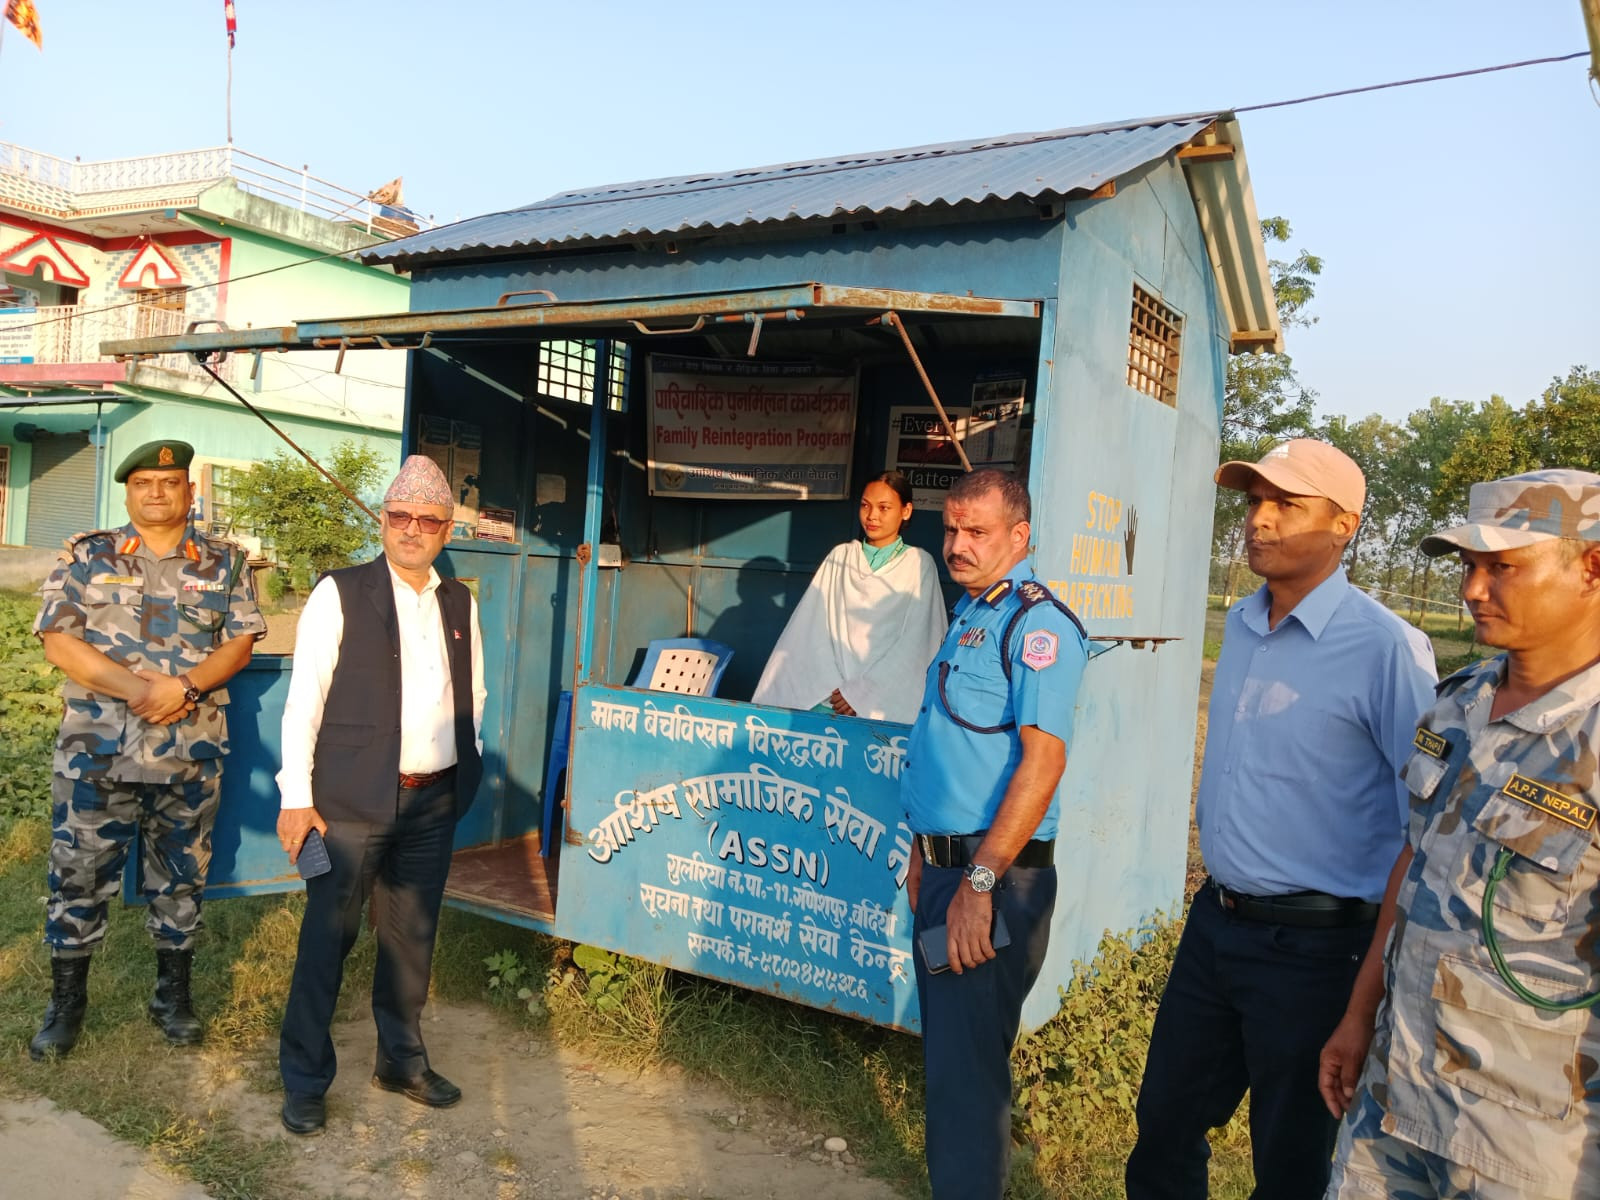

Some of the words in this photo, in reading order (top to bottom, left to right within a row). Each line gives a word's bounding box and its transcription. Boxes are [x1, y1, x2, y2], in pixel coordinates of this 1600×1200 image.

[656, 426, 698, 449] Family
[702, 426, 792, 450] Reintegration
[796, 428, 851, 450] Program
[1086, 489, 1122, 533] STOP
[1070, 533, 1121, 578] HUMAN
[591, 700, 640, 735] मानव
[588, 783, 682, 864] आशिष
[681, 762, 820, 822] सामाजिक
[824, 786, 886, 860] सेवा
[1542, 793, 1587, 823] NEPAL
[707, 821, 829, 888] (ASSN)
[640, 883, 690, 919] सूचना
[691, 896, 725, 926] तथा
[728, 911, 793, 948] परामर्श
[799, 915, 840, 959] सेवा
[688, 932, 736, 965] सम्पर्क
